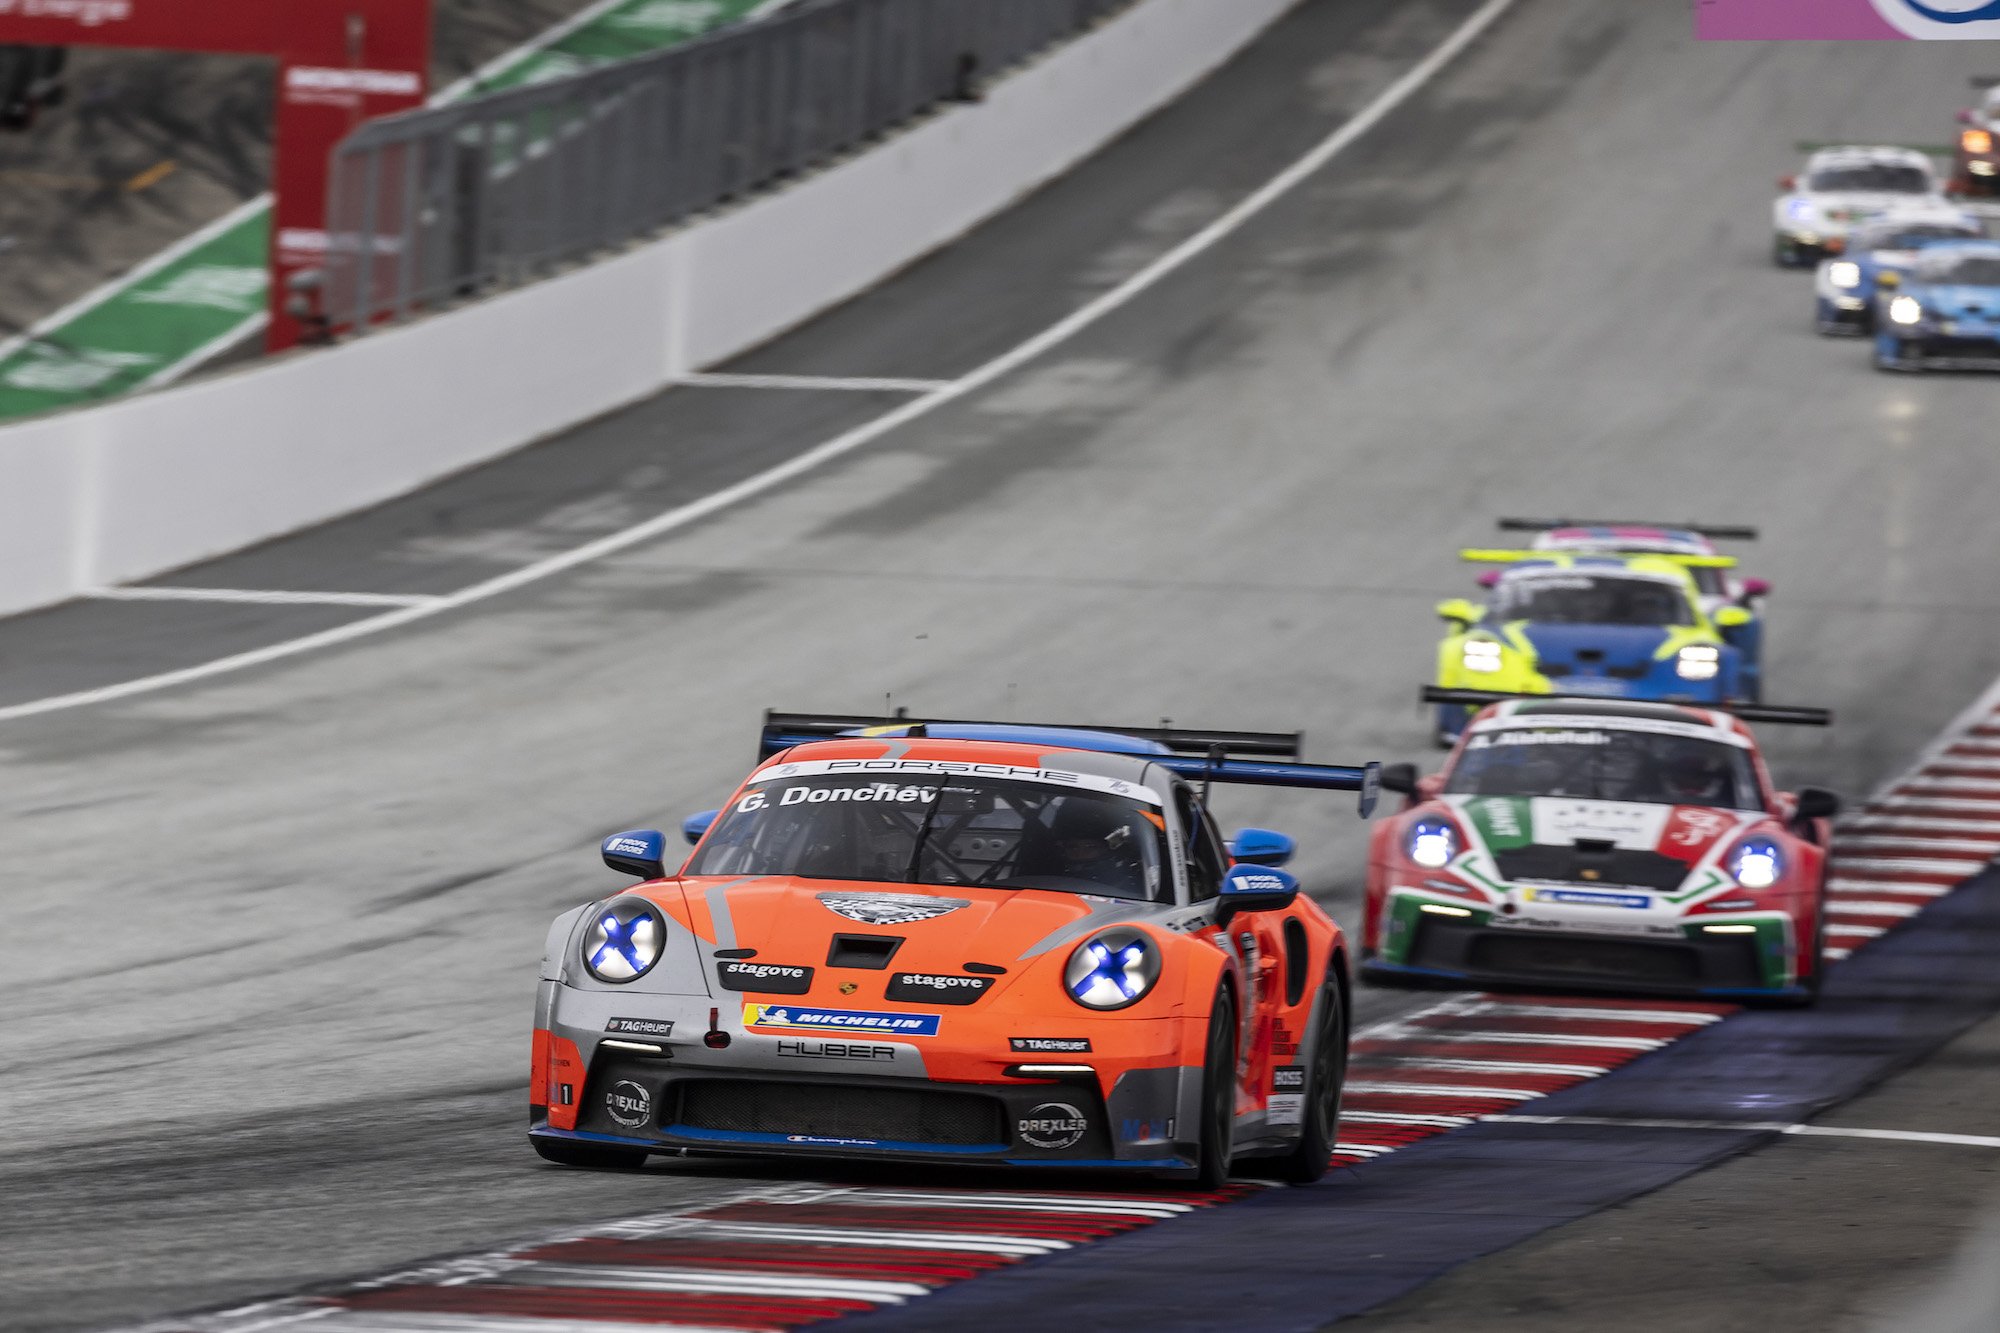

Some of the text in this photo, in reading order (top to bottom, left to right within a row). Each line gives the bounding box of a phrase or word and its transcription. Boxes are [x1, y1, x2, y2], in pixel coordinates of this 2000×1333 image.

[827, 760, 1079, 784] PORSCHE
[736, 793, 770, 813] G.
[779, 783, 937, 806] Donchev
[726, 962, 804, 978] stagove
[902, 974, 984, 989] stagove
[796, 1013, 924, 1029] MICHELIN
[777, 1040, 896, 1060] HUBER
[1018, 1119, 1088, 1135] DREXLER
